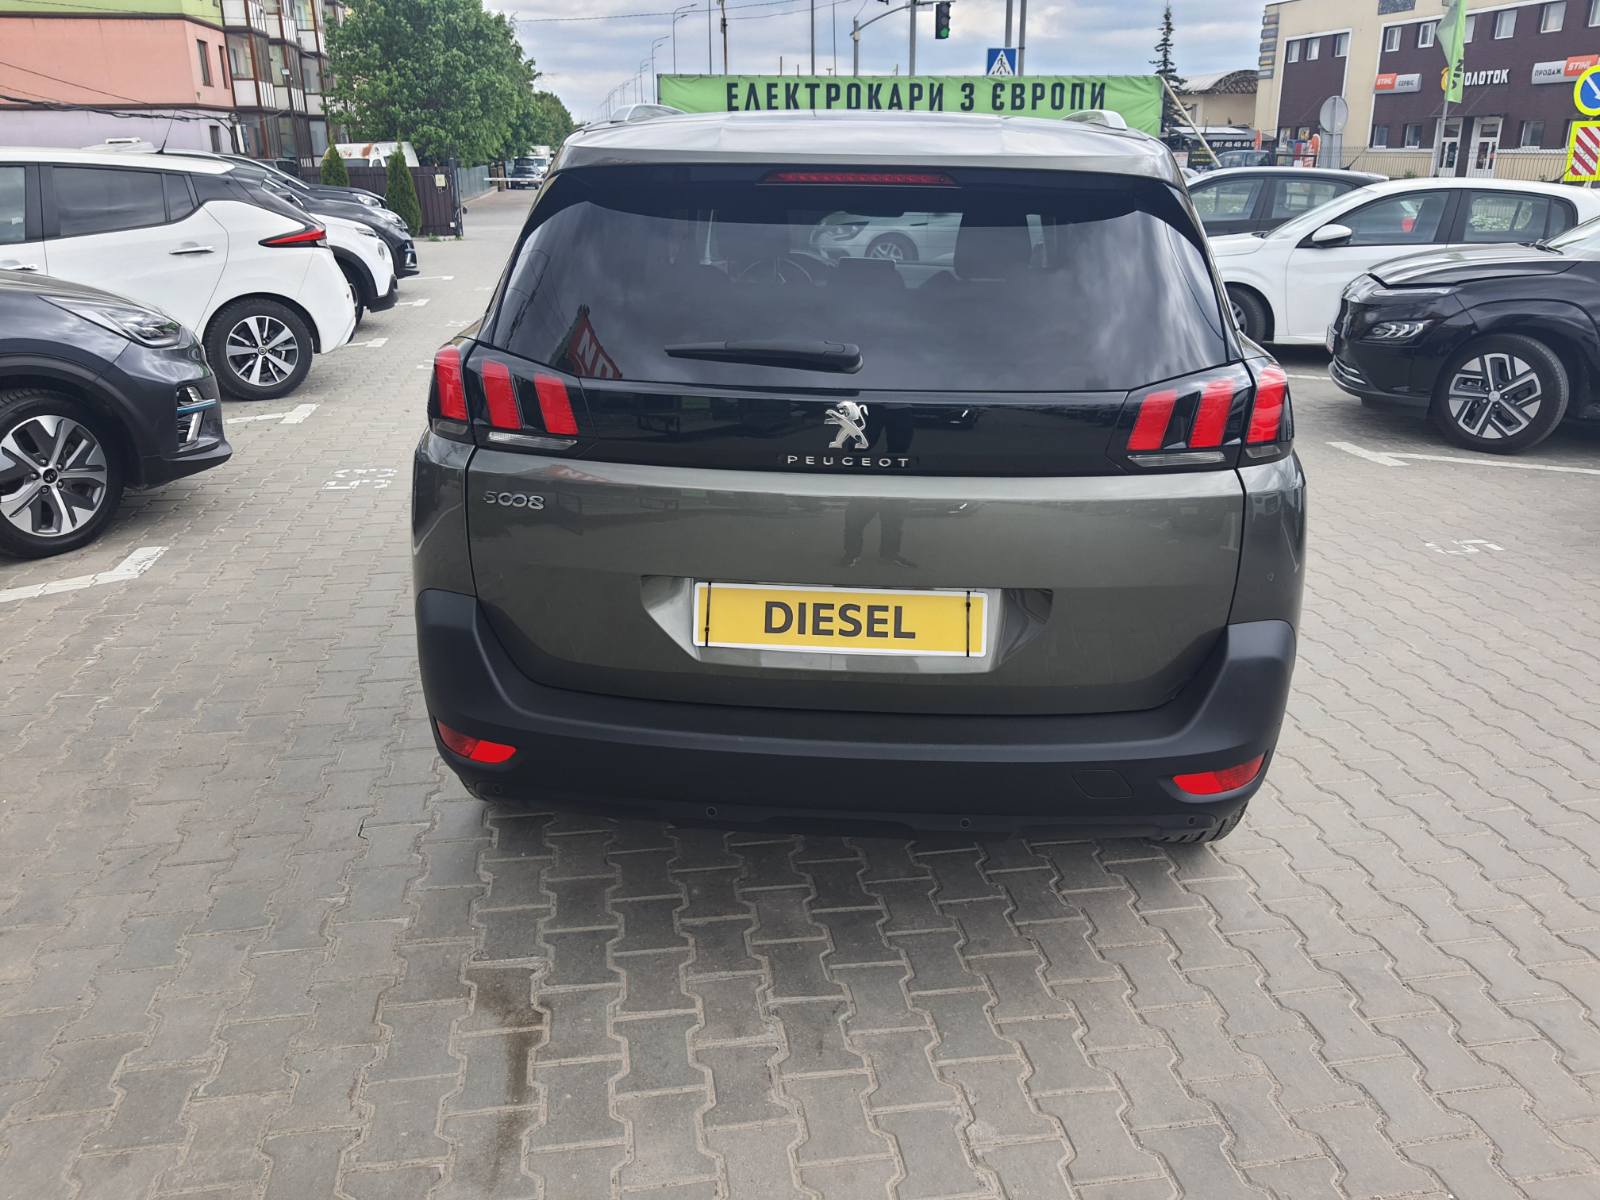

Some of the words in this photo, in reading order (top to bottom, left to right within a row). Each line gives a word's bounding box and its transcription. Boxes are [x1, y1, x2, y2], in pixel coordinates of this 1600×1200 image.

[1464, 69, 1509, 86] ОЛОТОК
[726, 82, 944, 112] ЕЛЕКТРОКАРИ
[991, 82, 1106, 111] ЄВРОПИ
[787, 455, 909, 468] PEUGEOT
[483, 490, 545, 510] 5008
[764, 600, 916, 639] DIESEL
